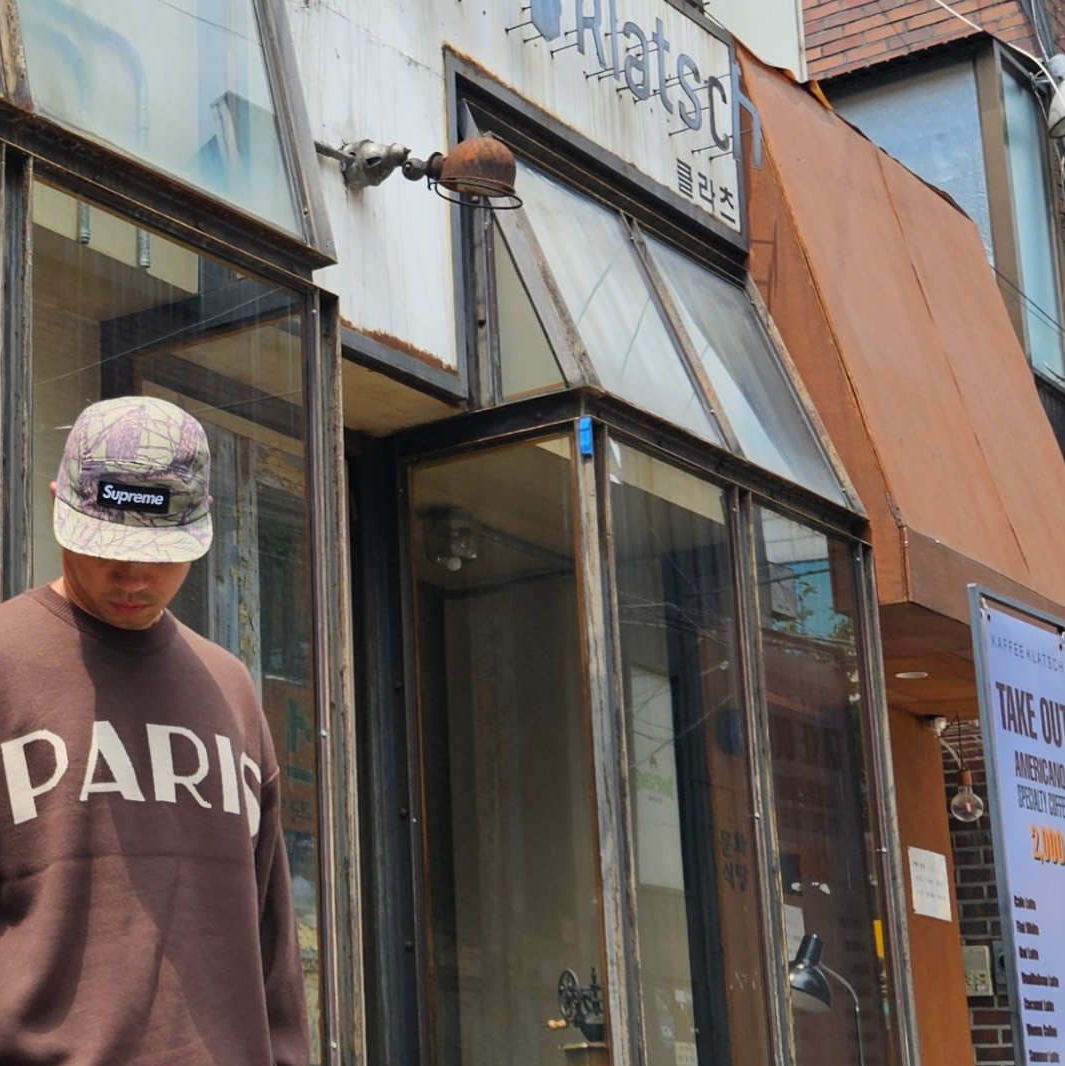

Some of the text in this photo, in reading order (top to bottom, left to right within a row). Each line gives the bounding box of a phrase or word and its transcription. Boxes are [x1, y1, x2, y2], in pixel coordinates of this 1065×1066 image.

[102, 484, 164, 505] Supreme
[991, 634, 1064, 673] KAFFEE KLATSCH
[995, 681, 1038, 740] TAKE
[0, 720, 261, 838] PARIS
[1017, 784, 1047, 814] SPECIALTY
